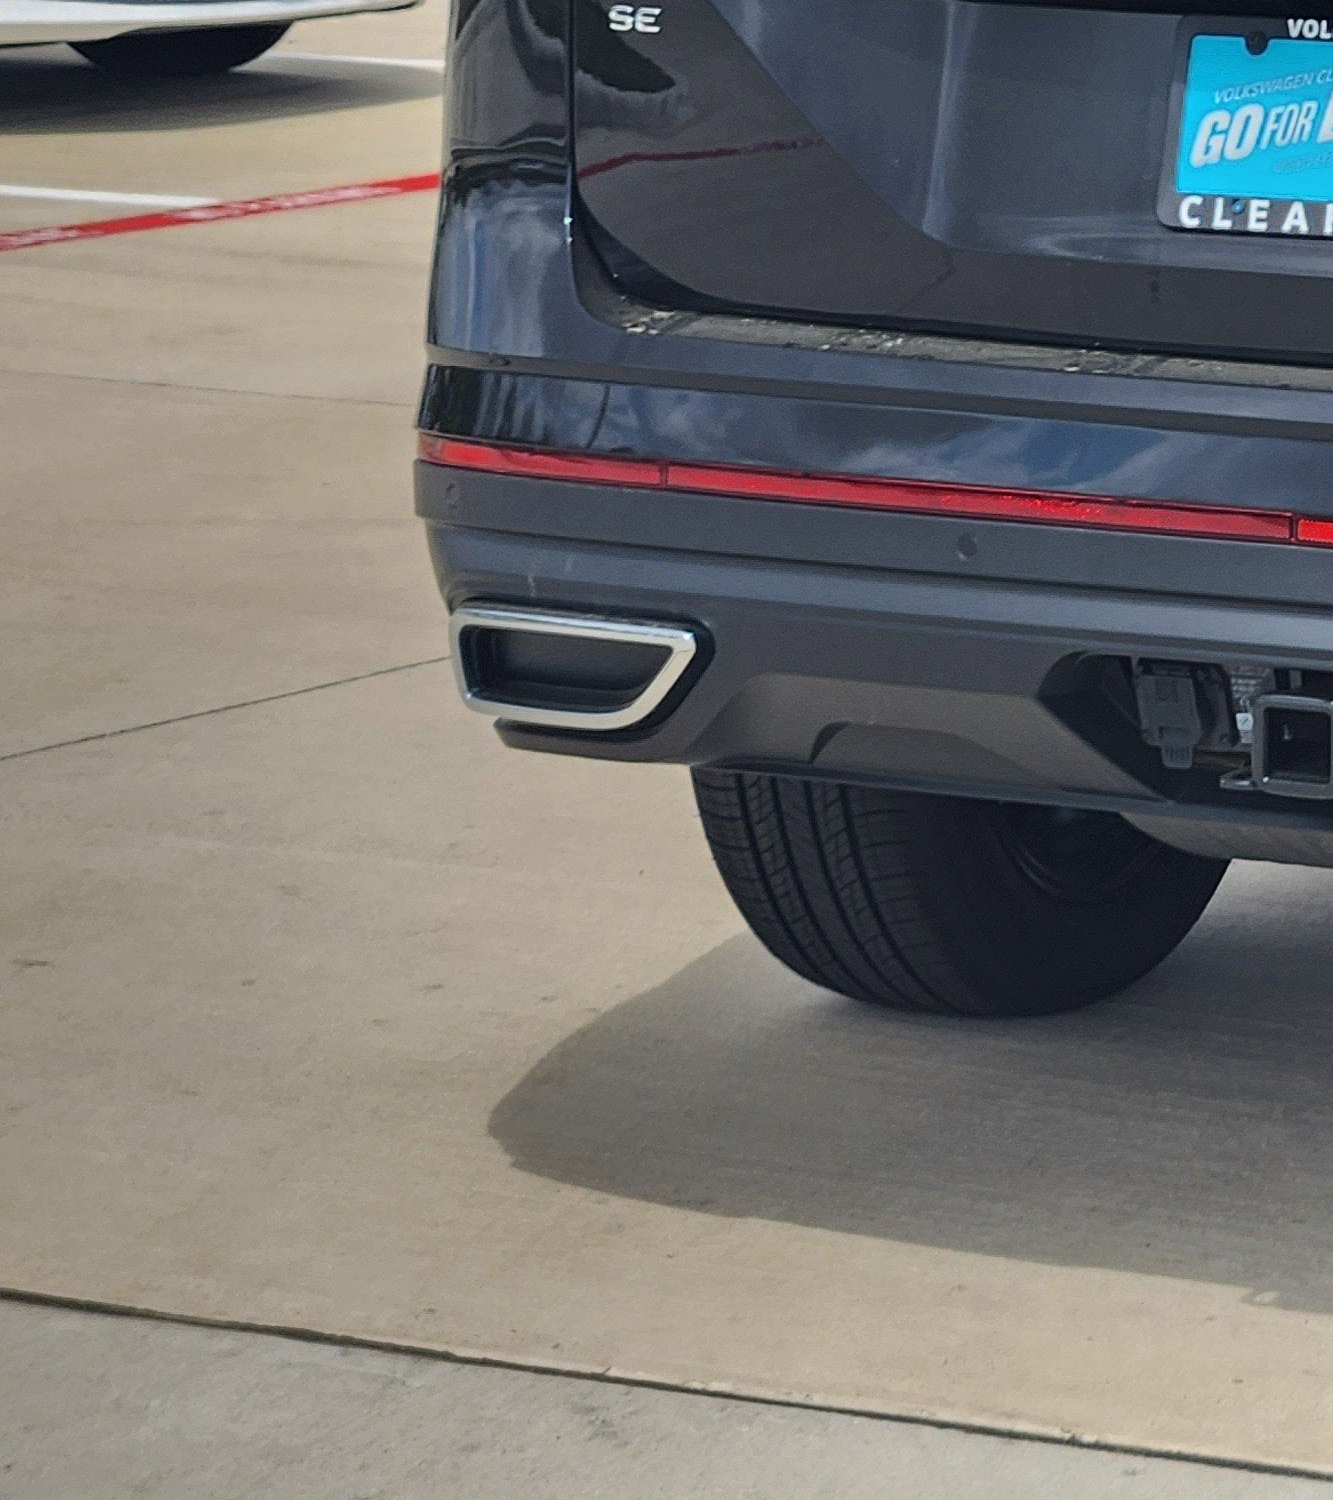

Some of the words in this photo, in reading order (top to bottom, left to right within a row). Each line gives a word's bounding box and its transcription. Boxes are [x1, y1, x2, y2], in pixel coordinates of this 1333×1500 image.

[608, 4, 662, 34] SE
[1213, 72, 1316, 104] VOLKSWAGEN
[1190, 104, 1265, 167] GO
[1261, 100, 1318, 150] FOR
